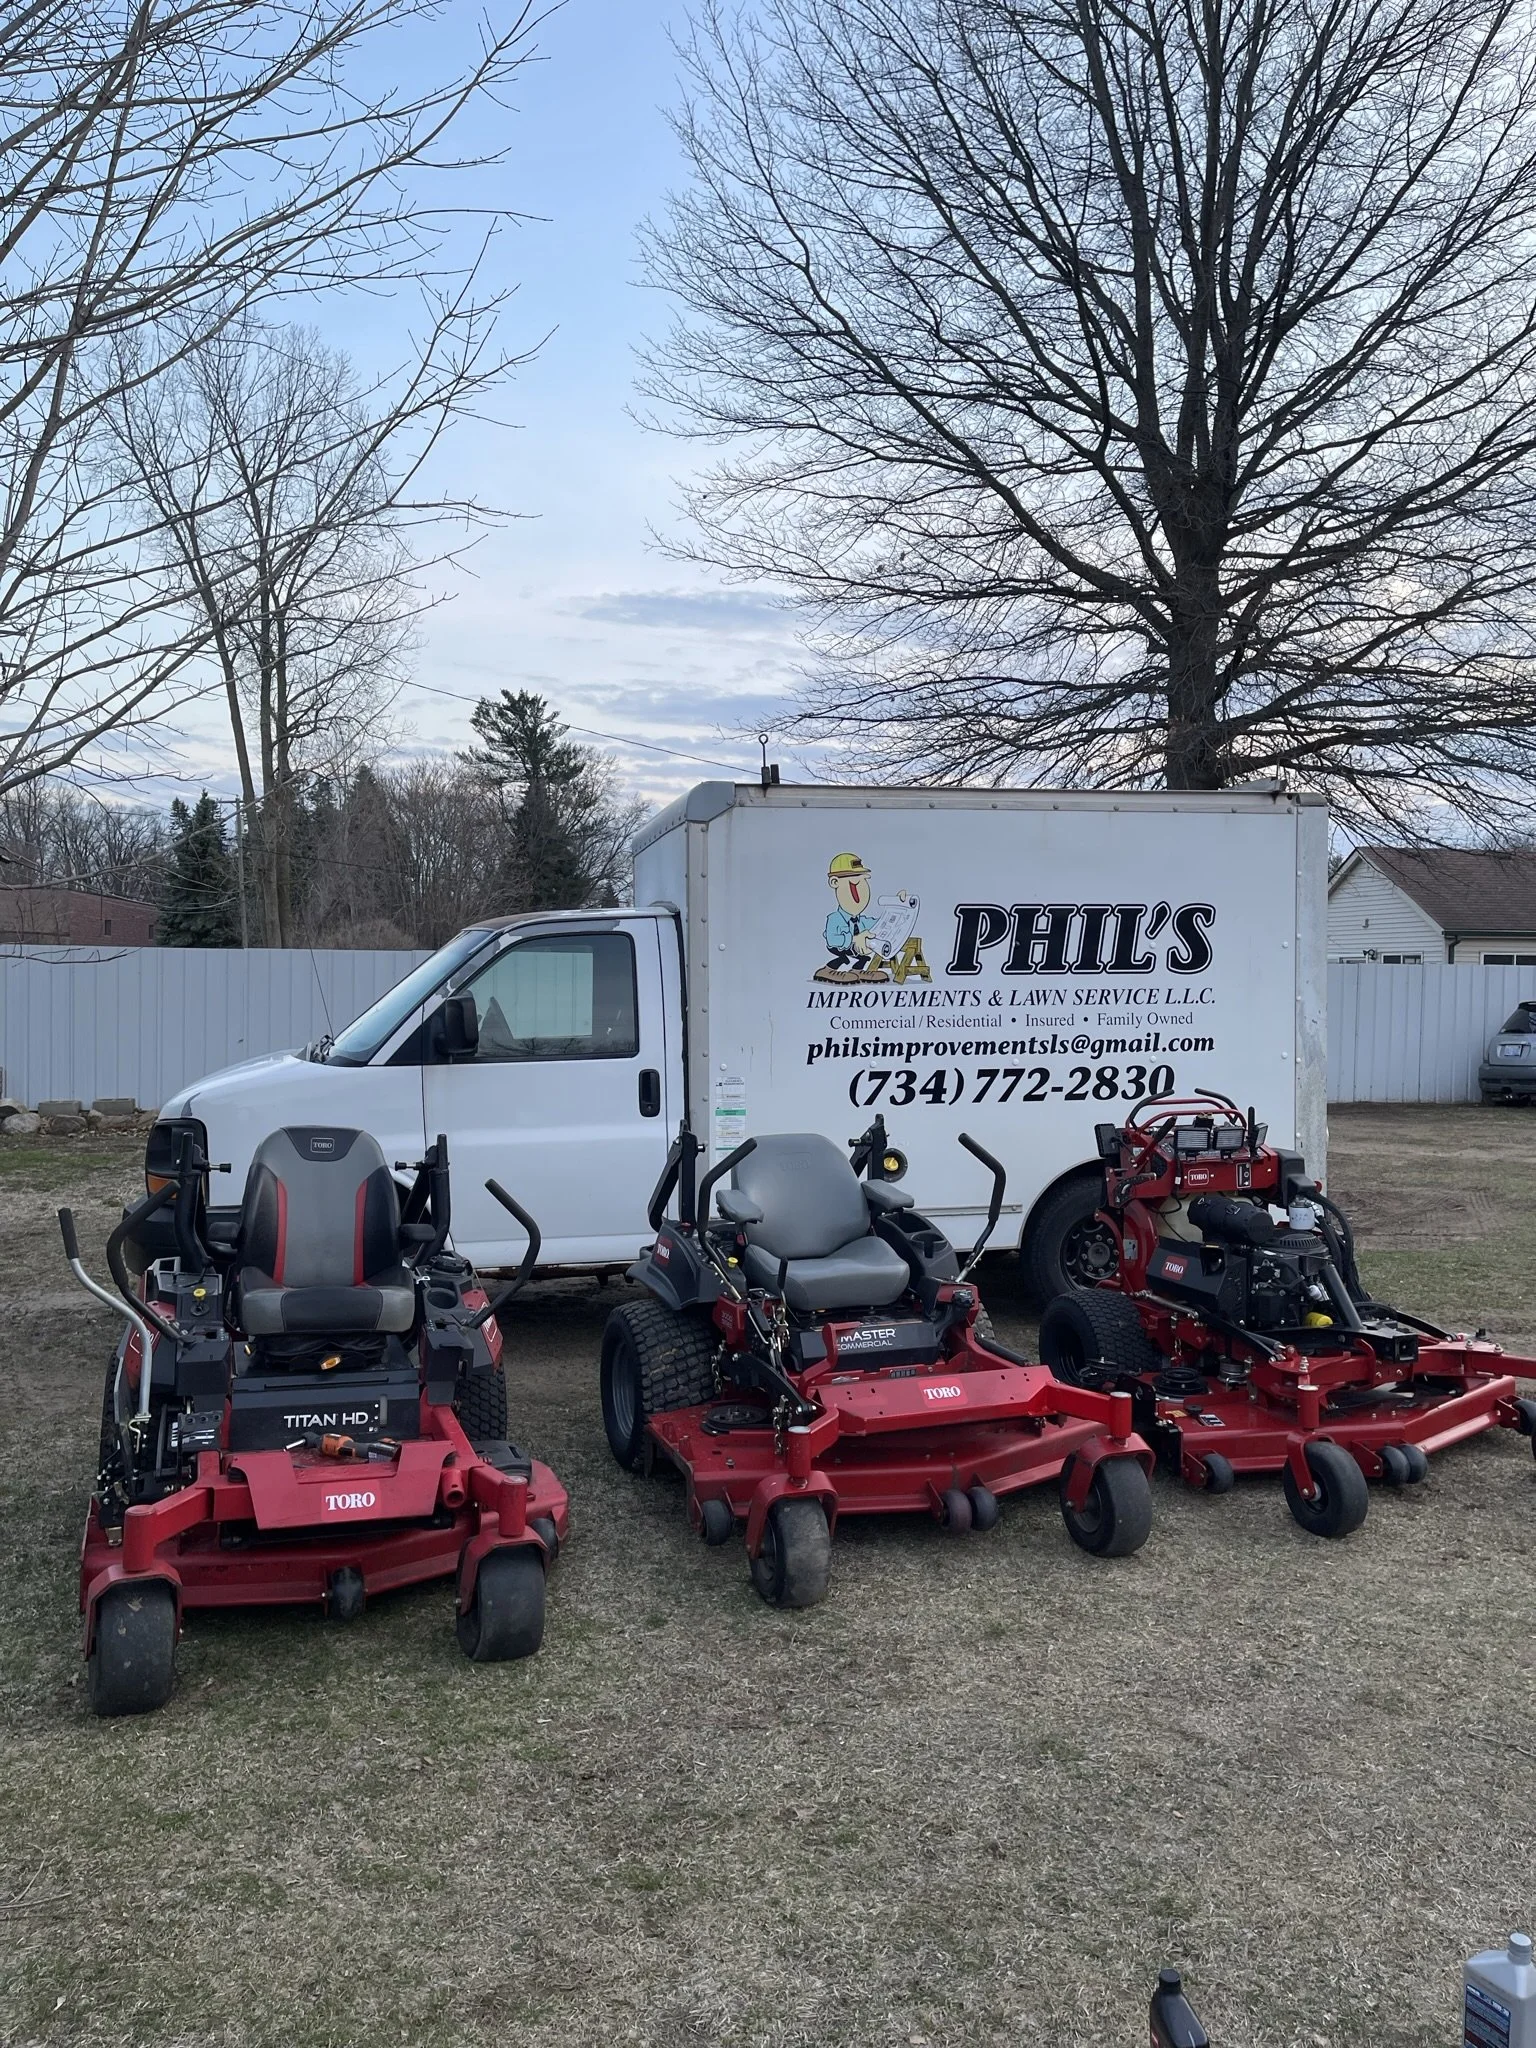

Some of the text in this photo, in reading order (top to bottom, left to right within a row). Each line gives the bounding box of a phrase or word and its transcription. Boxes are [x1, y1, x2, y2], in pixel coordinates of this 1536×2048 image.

[945, 900, 1217, 976] PHIL'S
[806, 987, 1216, 1009] IMPROVEMENTS & LAWN SERVICE L.L.C.
[1025, 1013, 1075, 1027] Insured
[1097, 1012, 1143, 1029] Family
[1147, 1011, 1193, 1026] Owned
[806, 1032, 1215, 1066] philsimprovementsls@gmail.com
[312, 1141, 333, 1150] TORO
[1190, 1173, 1208, 1181] TORO
[656, 1243, 670, 1260] TORO
[1165, 1261, 1184, 1274] TORO
[923, 1385, 961, 1400] TORO
[283, 1411, 369, 1428] TITAN HD
[325, 1491, 376, 1511] TORO
